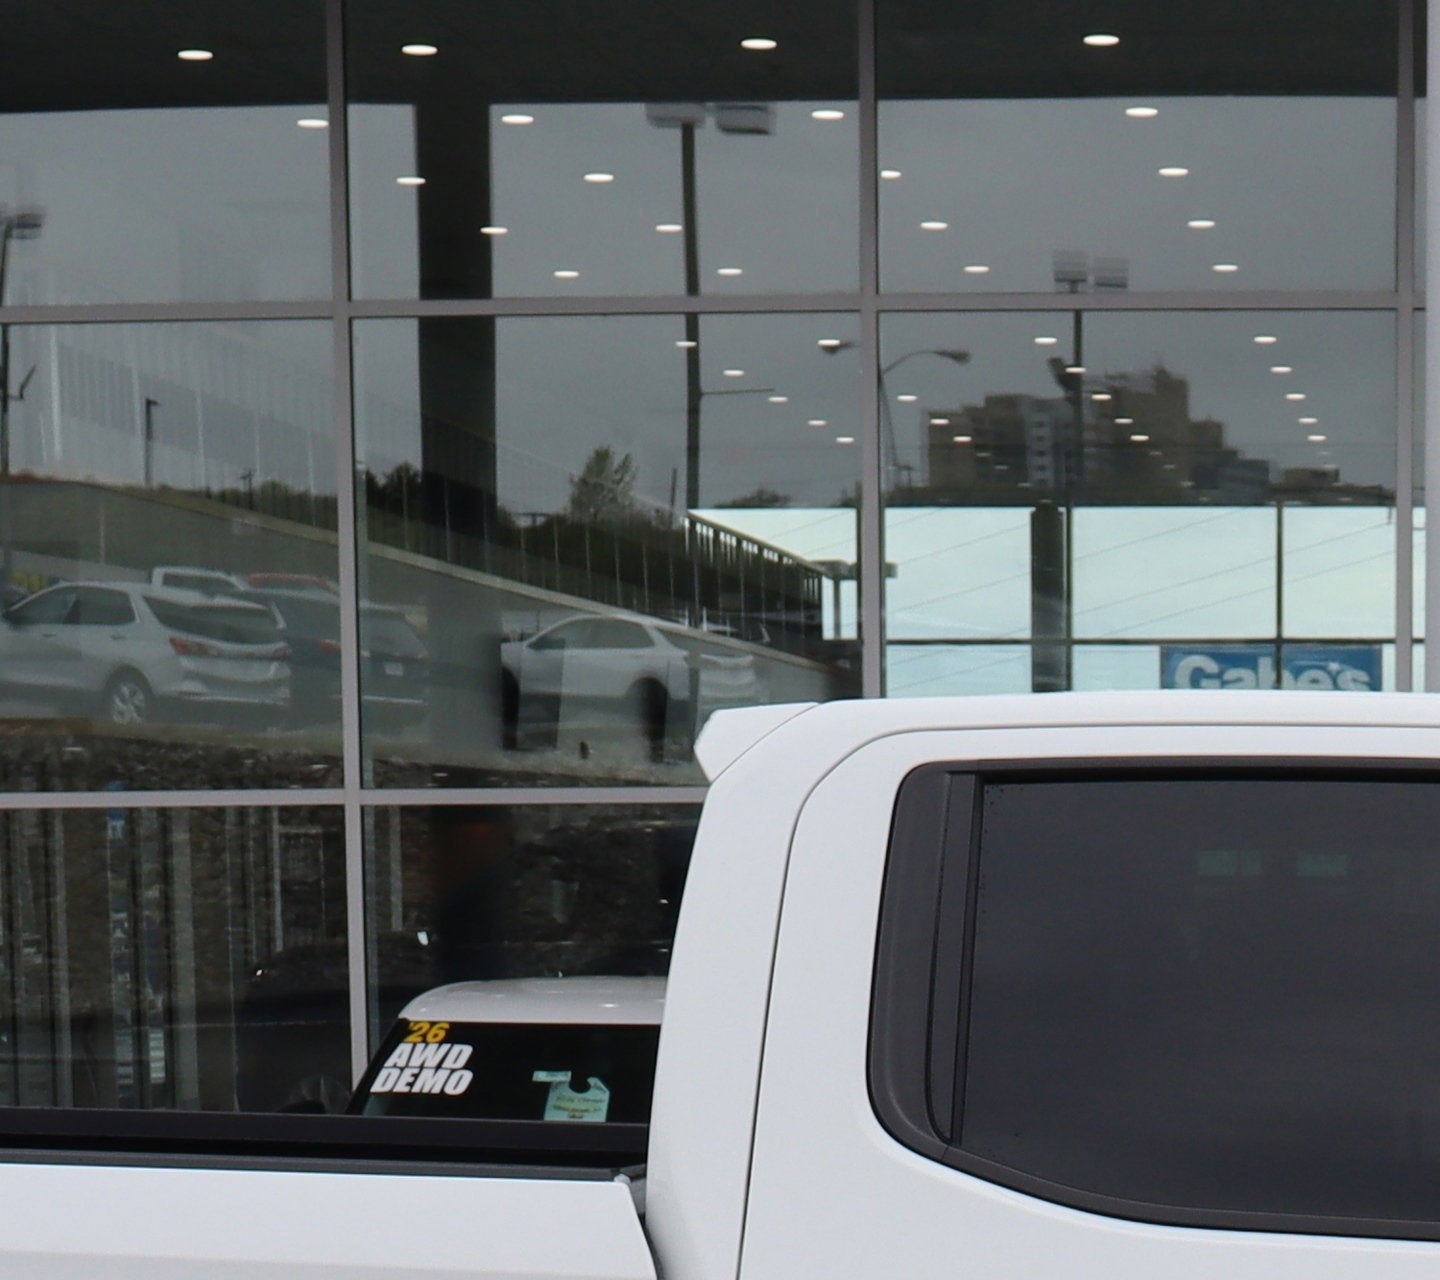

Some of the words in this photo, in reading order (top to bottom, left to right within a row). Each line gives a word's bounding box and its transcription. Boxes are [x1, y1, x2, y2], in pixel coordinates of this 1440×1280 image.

[1174, 654, 1371, 690] Gabe's
[383, 1043, 474, 1070] AWD
[369, 1067, 474, 1096] DEMO
